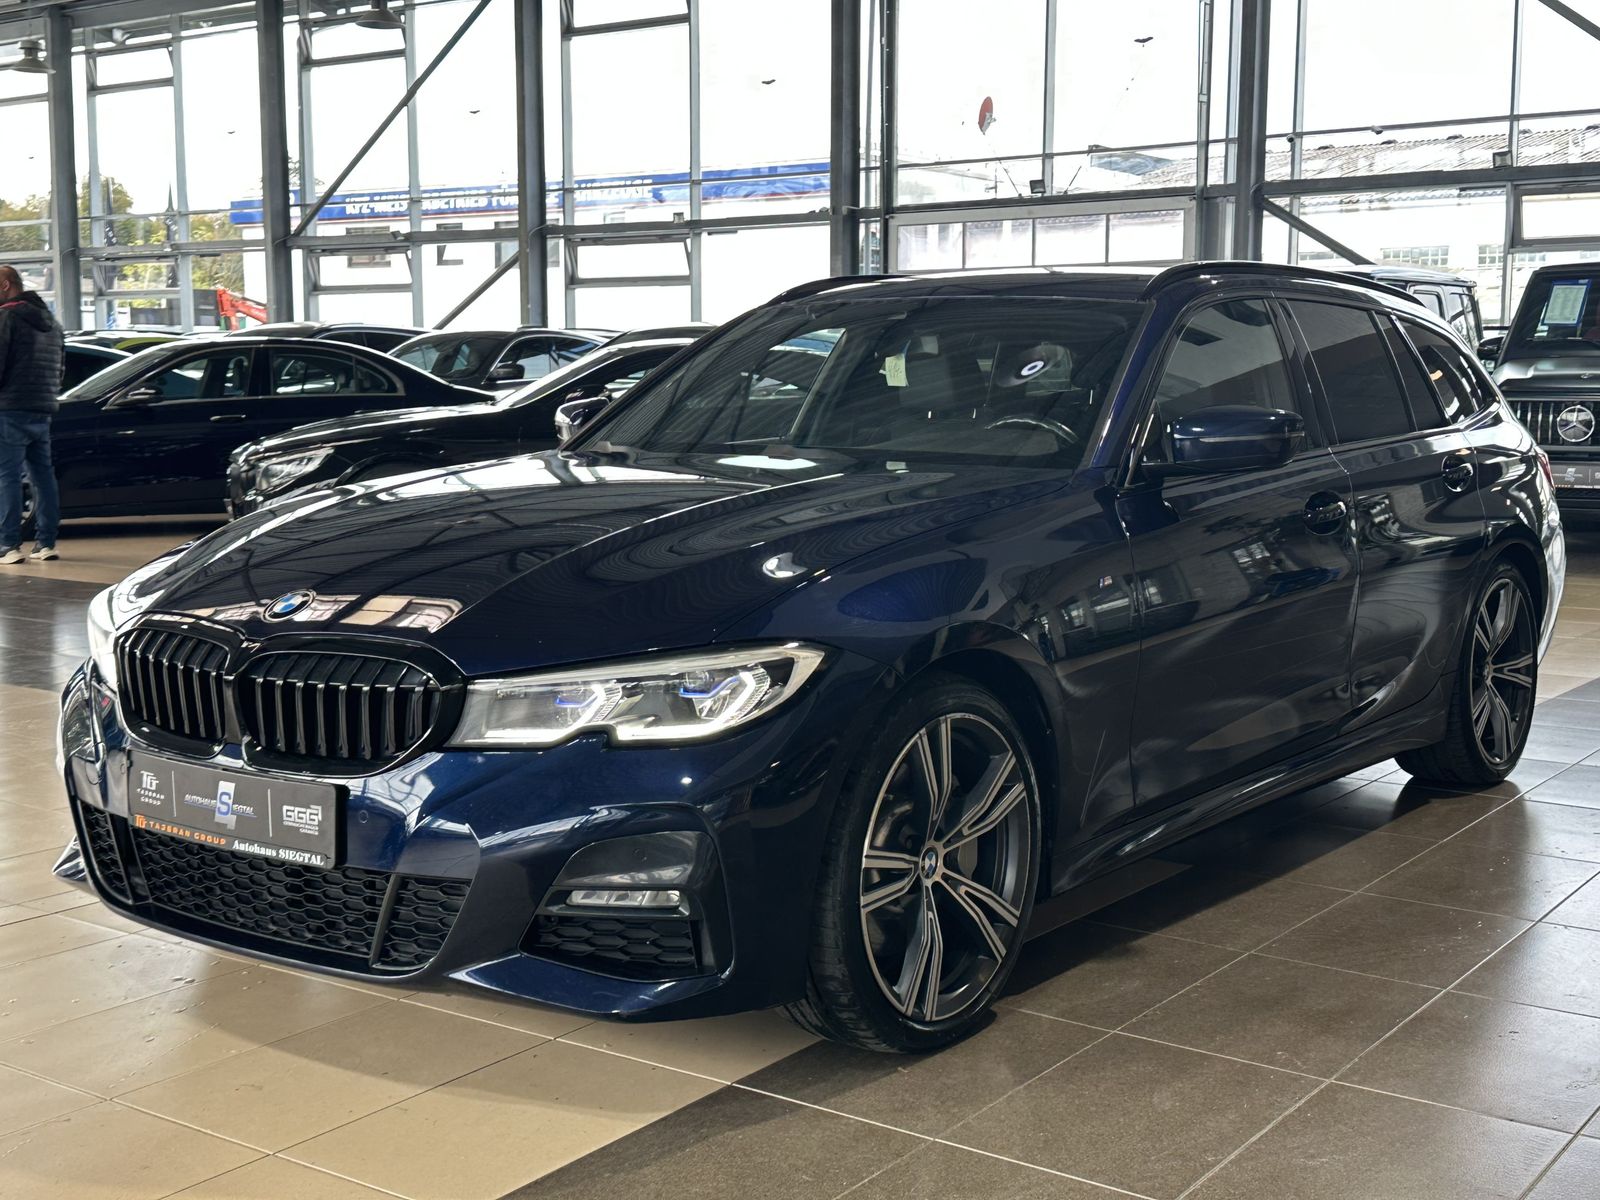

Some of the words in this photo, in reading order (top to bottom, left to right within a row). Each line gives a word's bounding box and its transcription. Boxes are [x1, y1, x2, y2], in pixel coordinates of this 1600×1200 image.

[282, 804, 321, 825] GGG
[194, 832, 226, 845] GROUP
[232, 840, 277, 857] Autohaus
[278, 848, 324, 866] SIEGTAL
